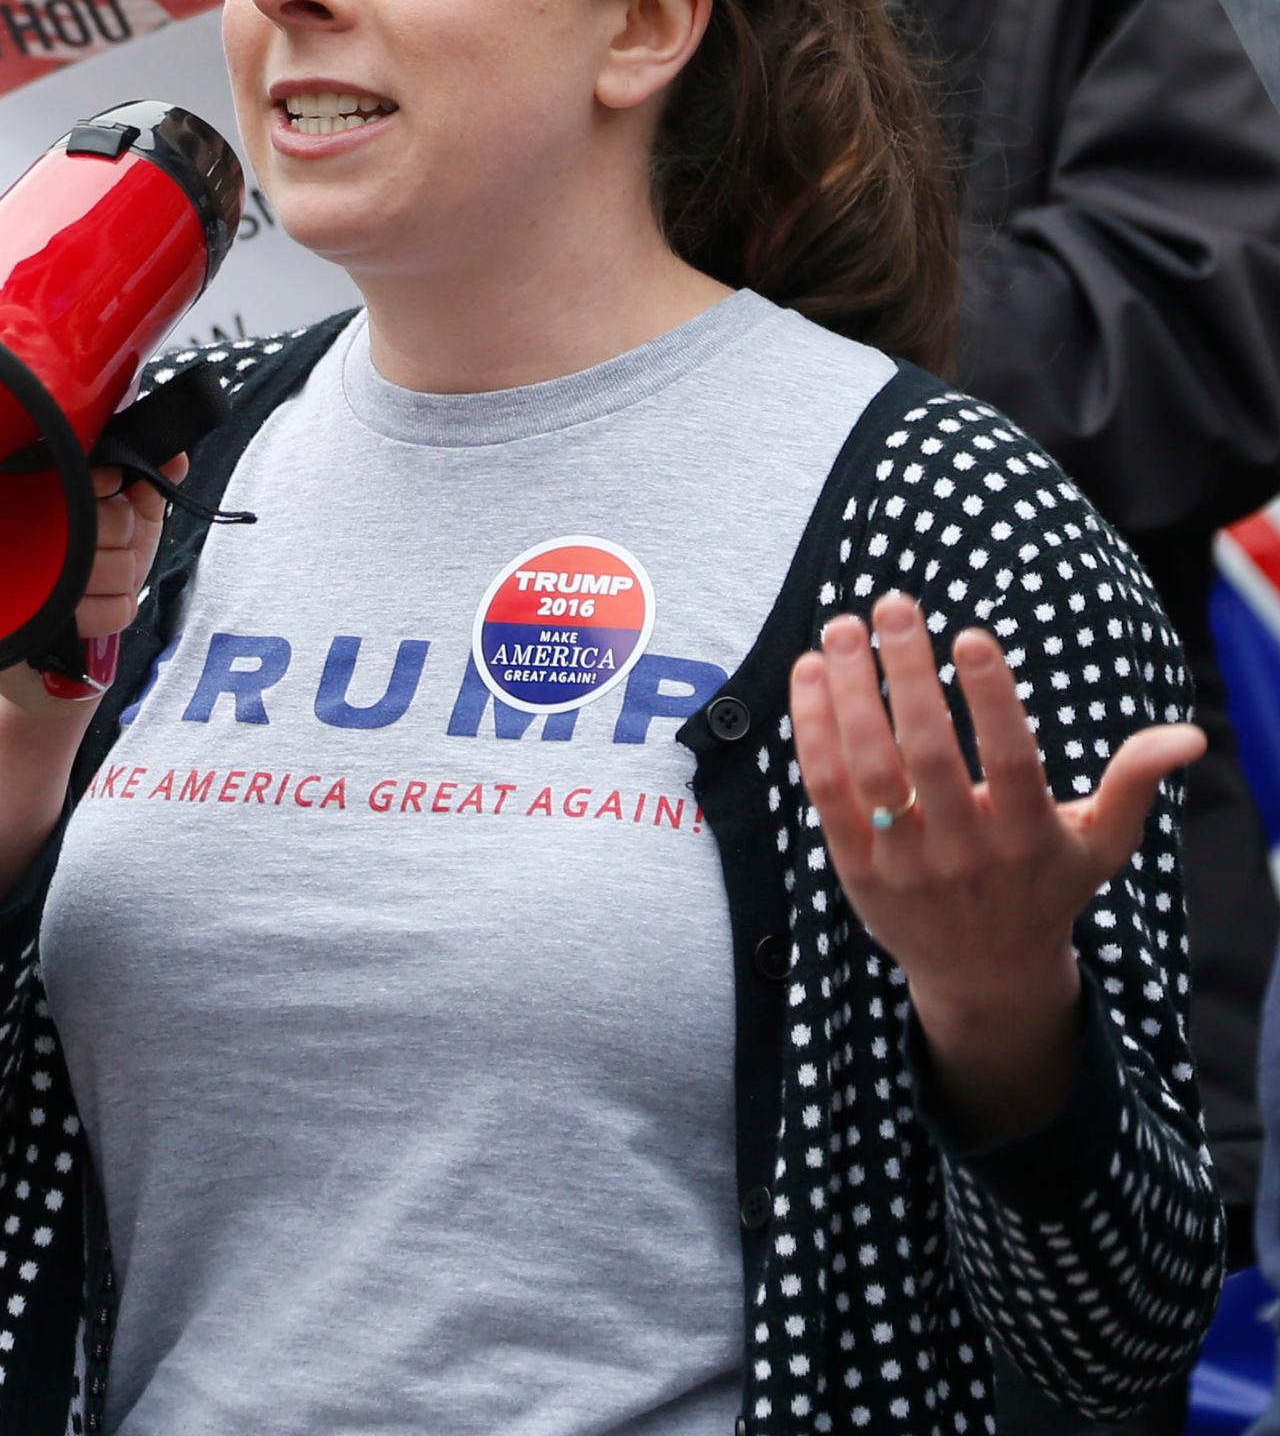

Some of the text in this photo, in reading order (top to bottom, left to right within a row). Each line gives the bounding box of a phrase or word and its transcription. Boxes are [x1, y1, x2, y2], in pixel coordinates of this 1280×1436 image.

[515, 570, 634, 596] TRUMP
[536, 597, 596, 618] 2016
[539, 630, 579, 645] MAKE
[490, 643, 616, 670] AMERICA
[503, 669, 597, 685] GREAT AGAIN!
[86, 764, 704, 834] AKE AMERICA GREAT AGAIN!
